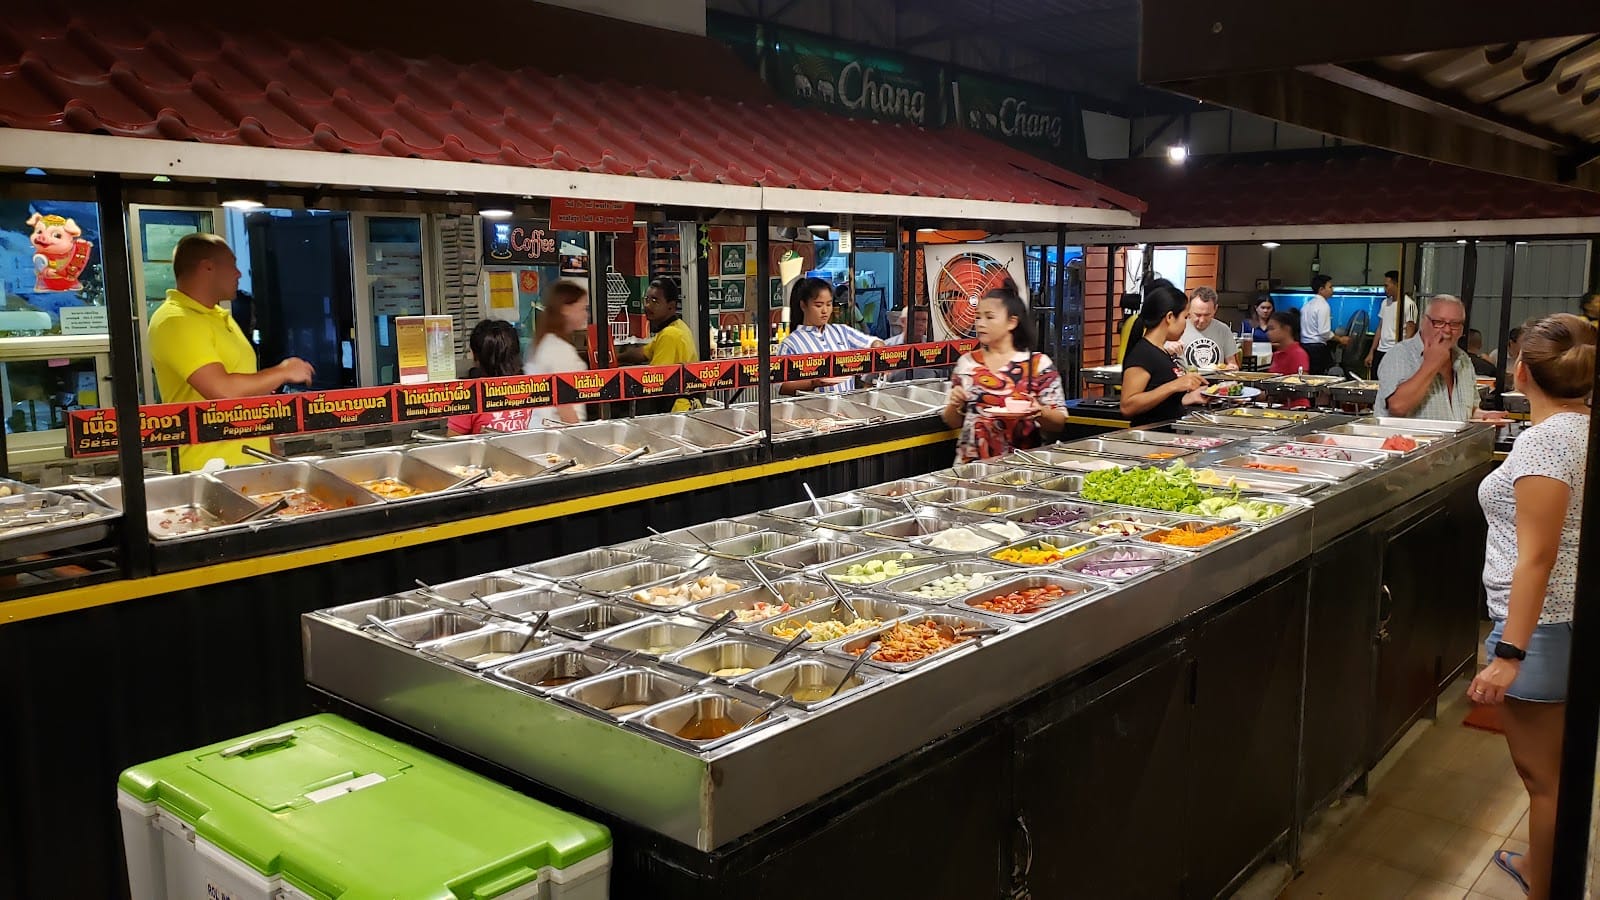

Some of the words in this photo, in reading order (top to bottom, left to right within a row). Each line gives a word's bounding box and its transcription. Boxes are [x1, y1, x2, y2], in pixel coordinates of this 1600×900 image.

[838, 61, 925, 123] Chang
[1000, 97, 1062, 147] Chang
[511, 227, 555, 259] Coffee
[579, 391, 601, 399] Chicken
[486, 400, 504, 408] Black
[504, 398, 526, 407] Pepper
[526, 395, 550, 404] Chicken
[406, 407, 428, 416] Honey
[443, 404, 470, 413] Chicken
[150, 431, 186, 442] Meat
[223, 426, 252, 436] Pepper
